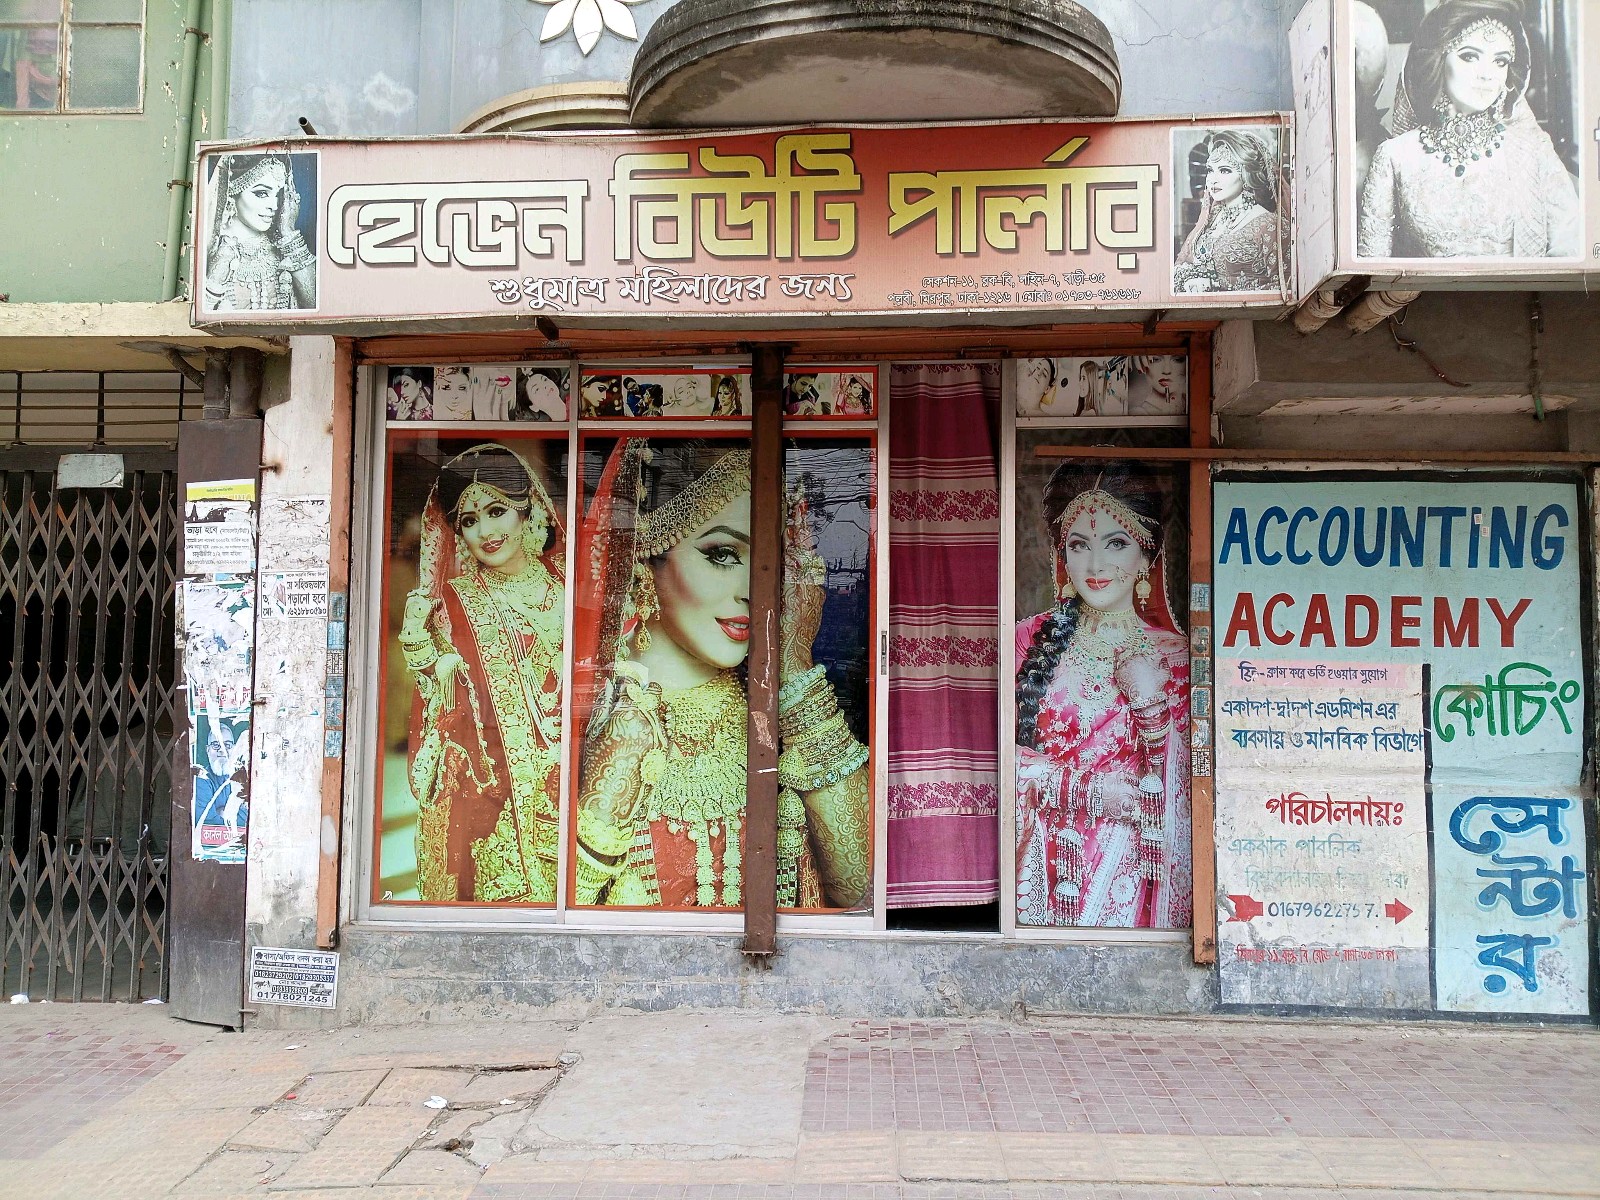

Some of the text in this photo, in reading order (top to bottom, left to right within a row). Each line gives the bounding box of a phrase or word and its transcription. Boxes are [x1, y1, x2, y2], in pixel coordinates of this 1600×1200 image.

[327, 133, 1160, 270] হেভেন বিউটি পার্লার
[489, 265, 855, 312] শুধুমাত্র মহিলাদের জন্য
[922, 275, 979, 288] সেকশন-১১,
[1018, 272, 1060, 287] লাইন-৭,
[1063, 269, 1106, 285] বাড়ী-৩৫
[957, 290, 1012, 304] ঢাকা-১২১৬
[1218, 504, 1569, 570] ACCOUNTING
[1222, 593, 1533, 648] ACADEMY
[1375, 702, 1400, 720] এর
[1433, 661, 1581, 744] কোচিং
[1304, 726, 1370, 751] মানবিক
[1295, 833, 1364, 859] পাবলিক
